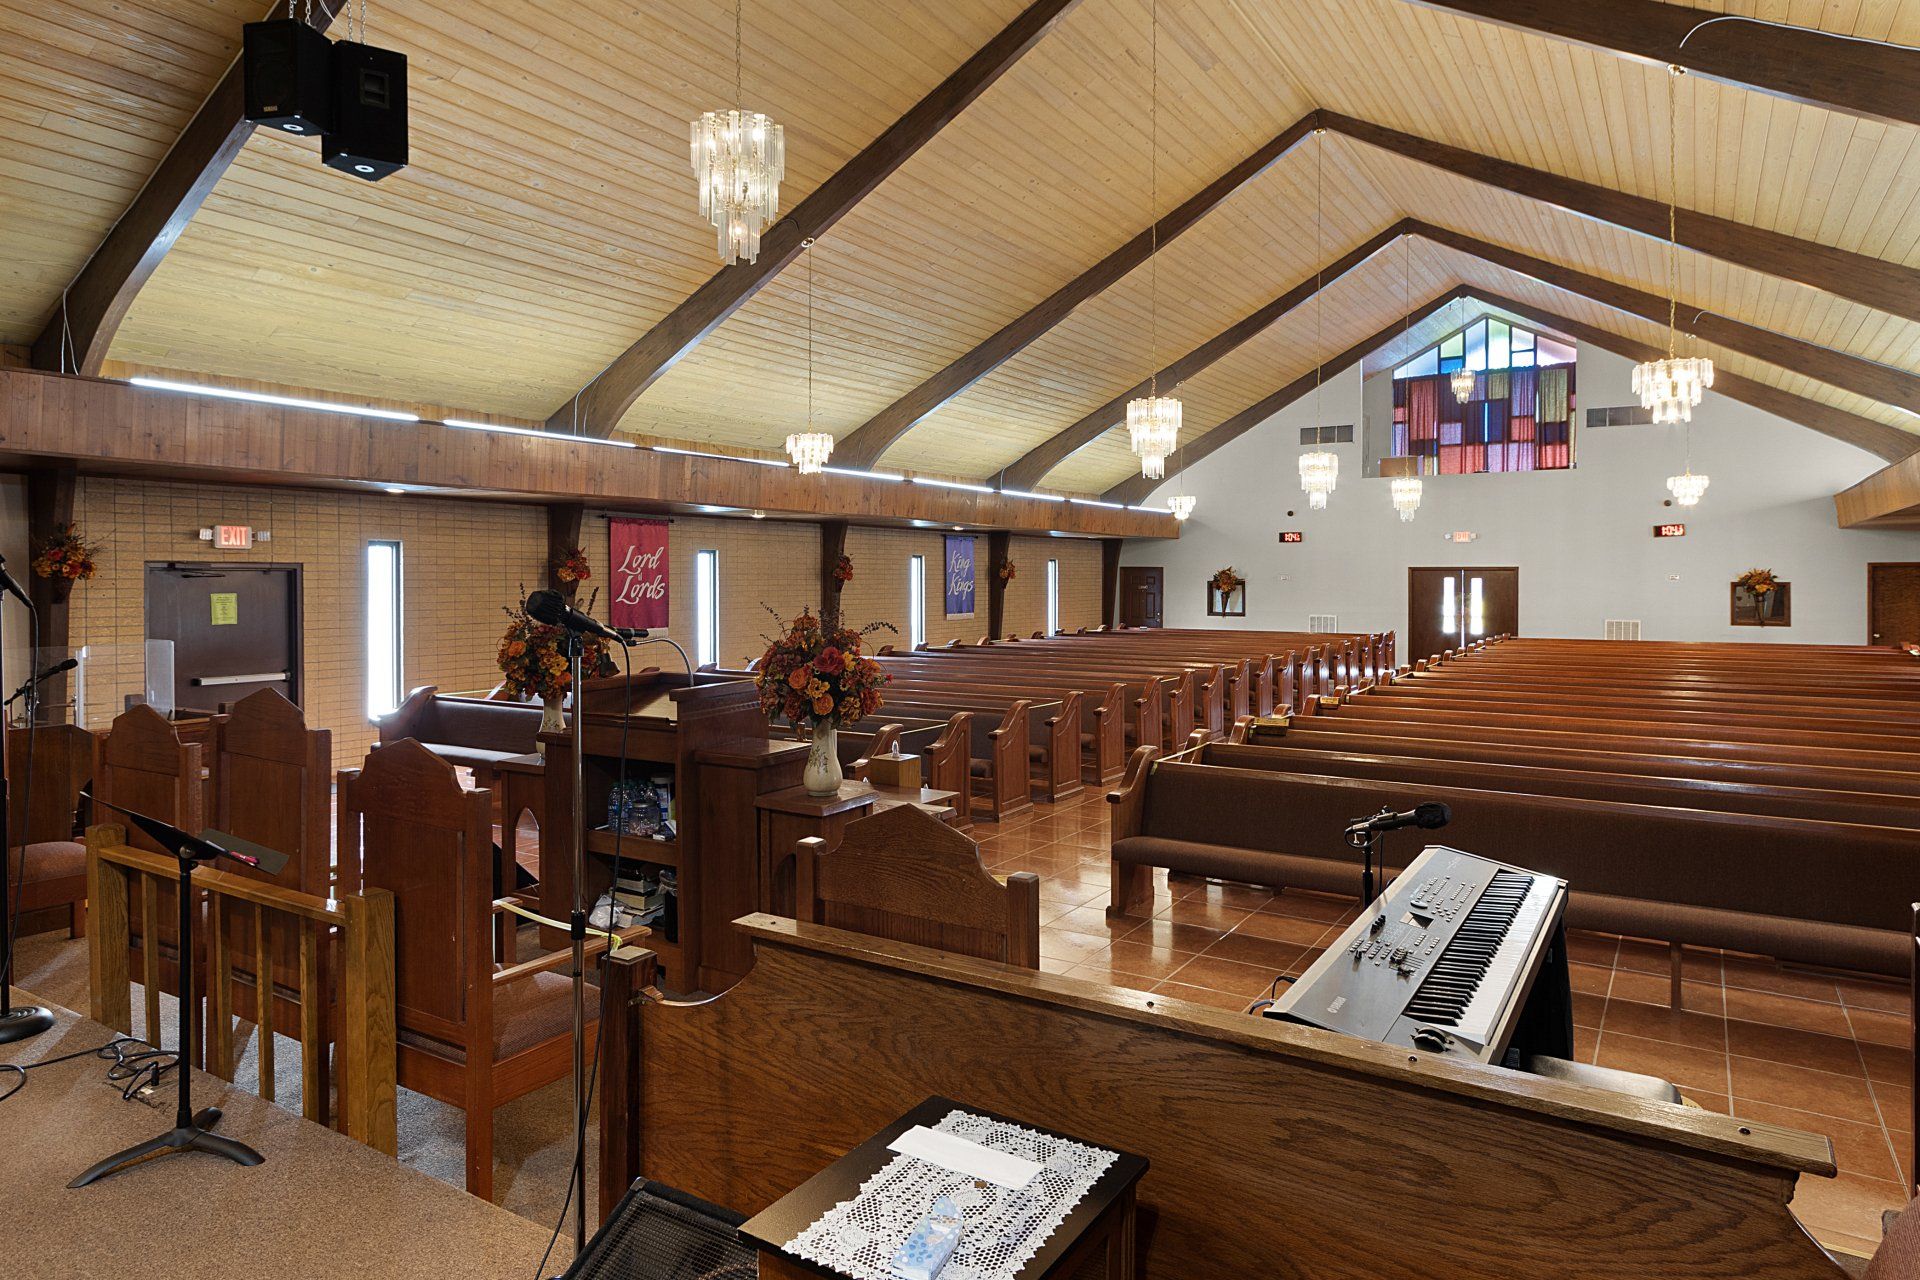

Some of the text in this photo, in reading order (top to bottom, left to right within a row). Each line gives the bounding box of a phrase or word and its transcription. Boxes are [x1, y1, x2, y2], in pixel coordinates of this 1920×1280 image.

[221, 526, 247, 545] EXIT
[617, 545, 665, 574] Lord
[949, 550, 971, 577] King
[615, 574, 666, 605] Lords
[948, 573, 974, 600] Kings
